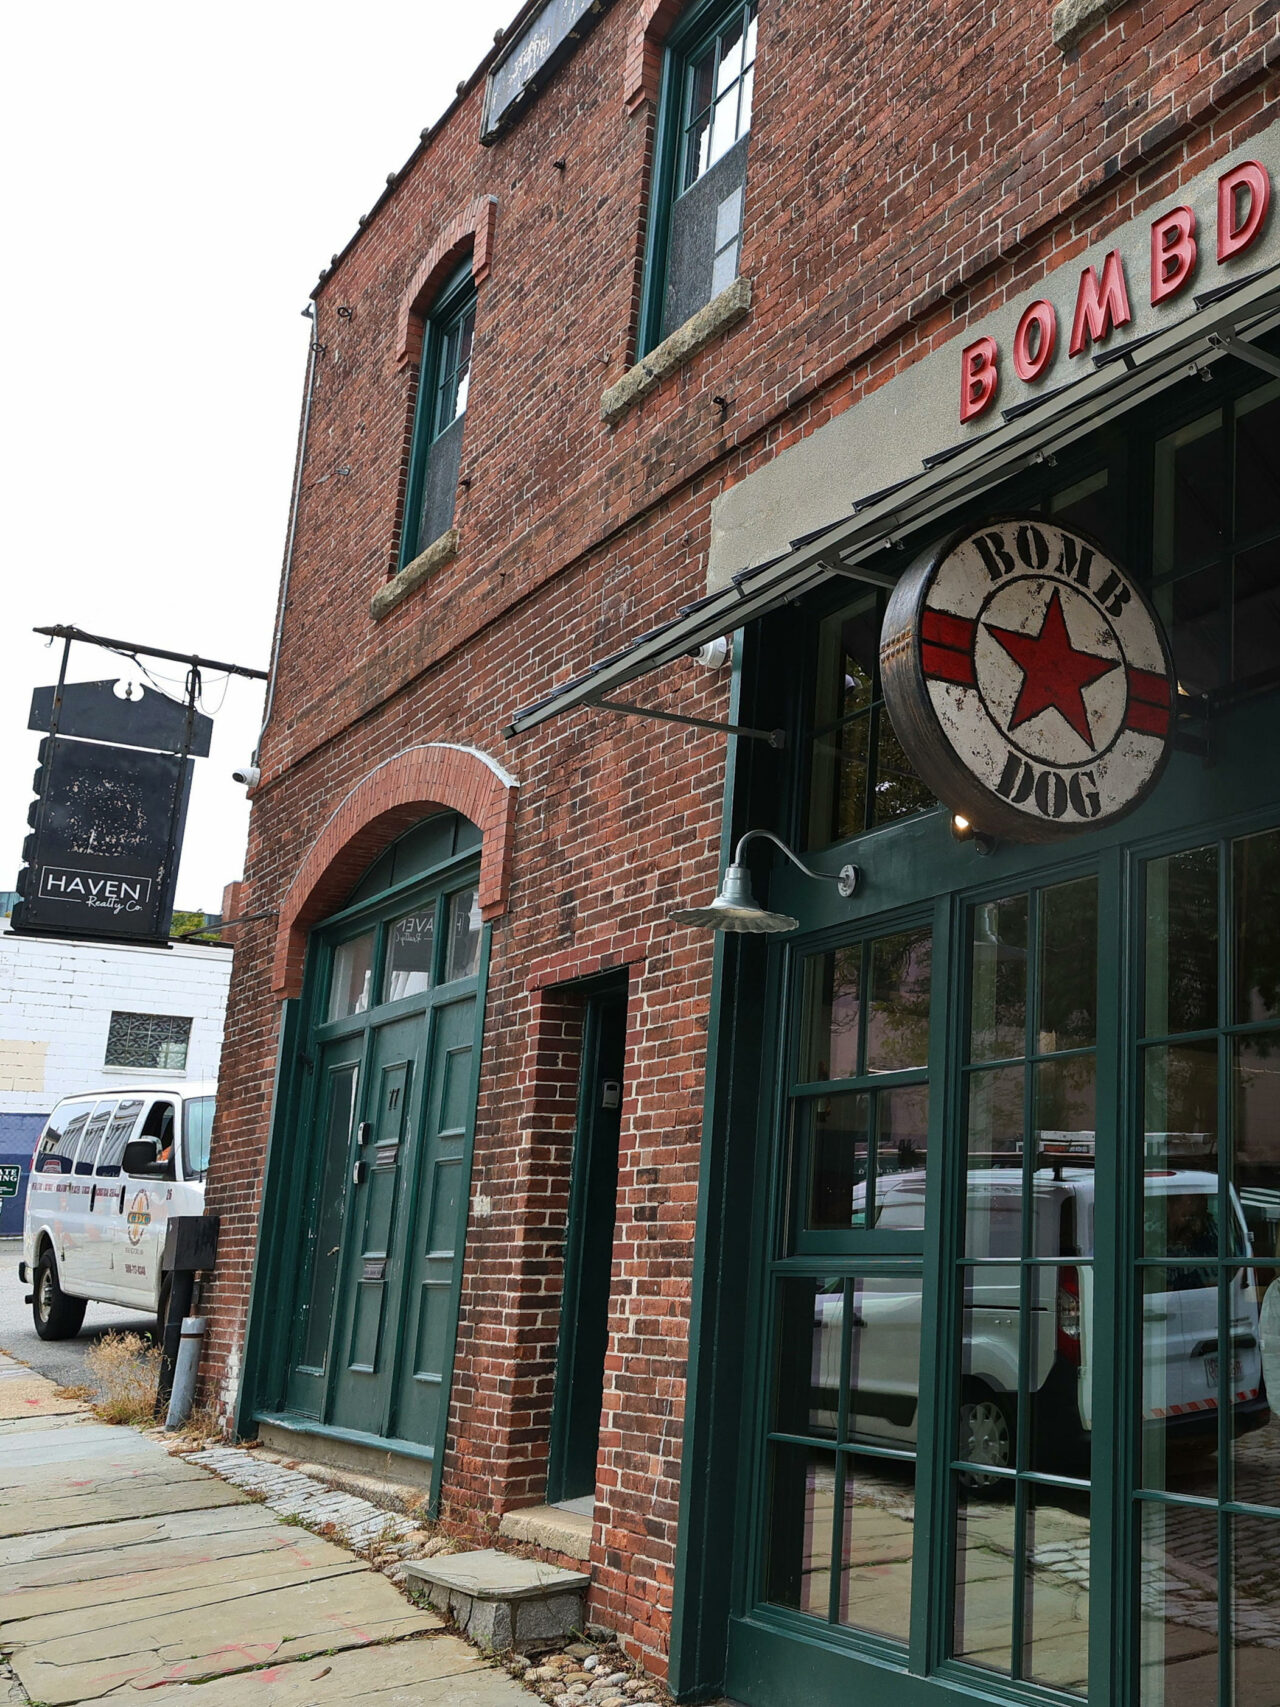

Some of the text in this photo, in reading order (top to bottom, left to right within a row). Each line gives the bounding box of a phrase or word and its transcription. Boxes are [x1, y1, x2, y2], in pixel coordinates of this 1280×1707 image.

[971, 524, 1131, 618] BOMB
[995, 749, 1101, 819] DOG
[47, 874, 141, 900] HAVEN
[86, 896, 143, 914] Realty Co.
